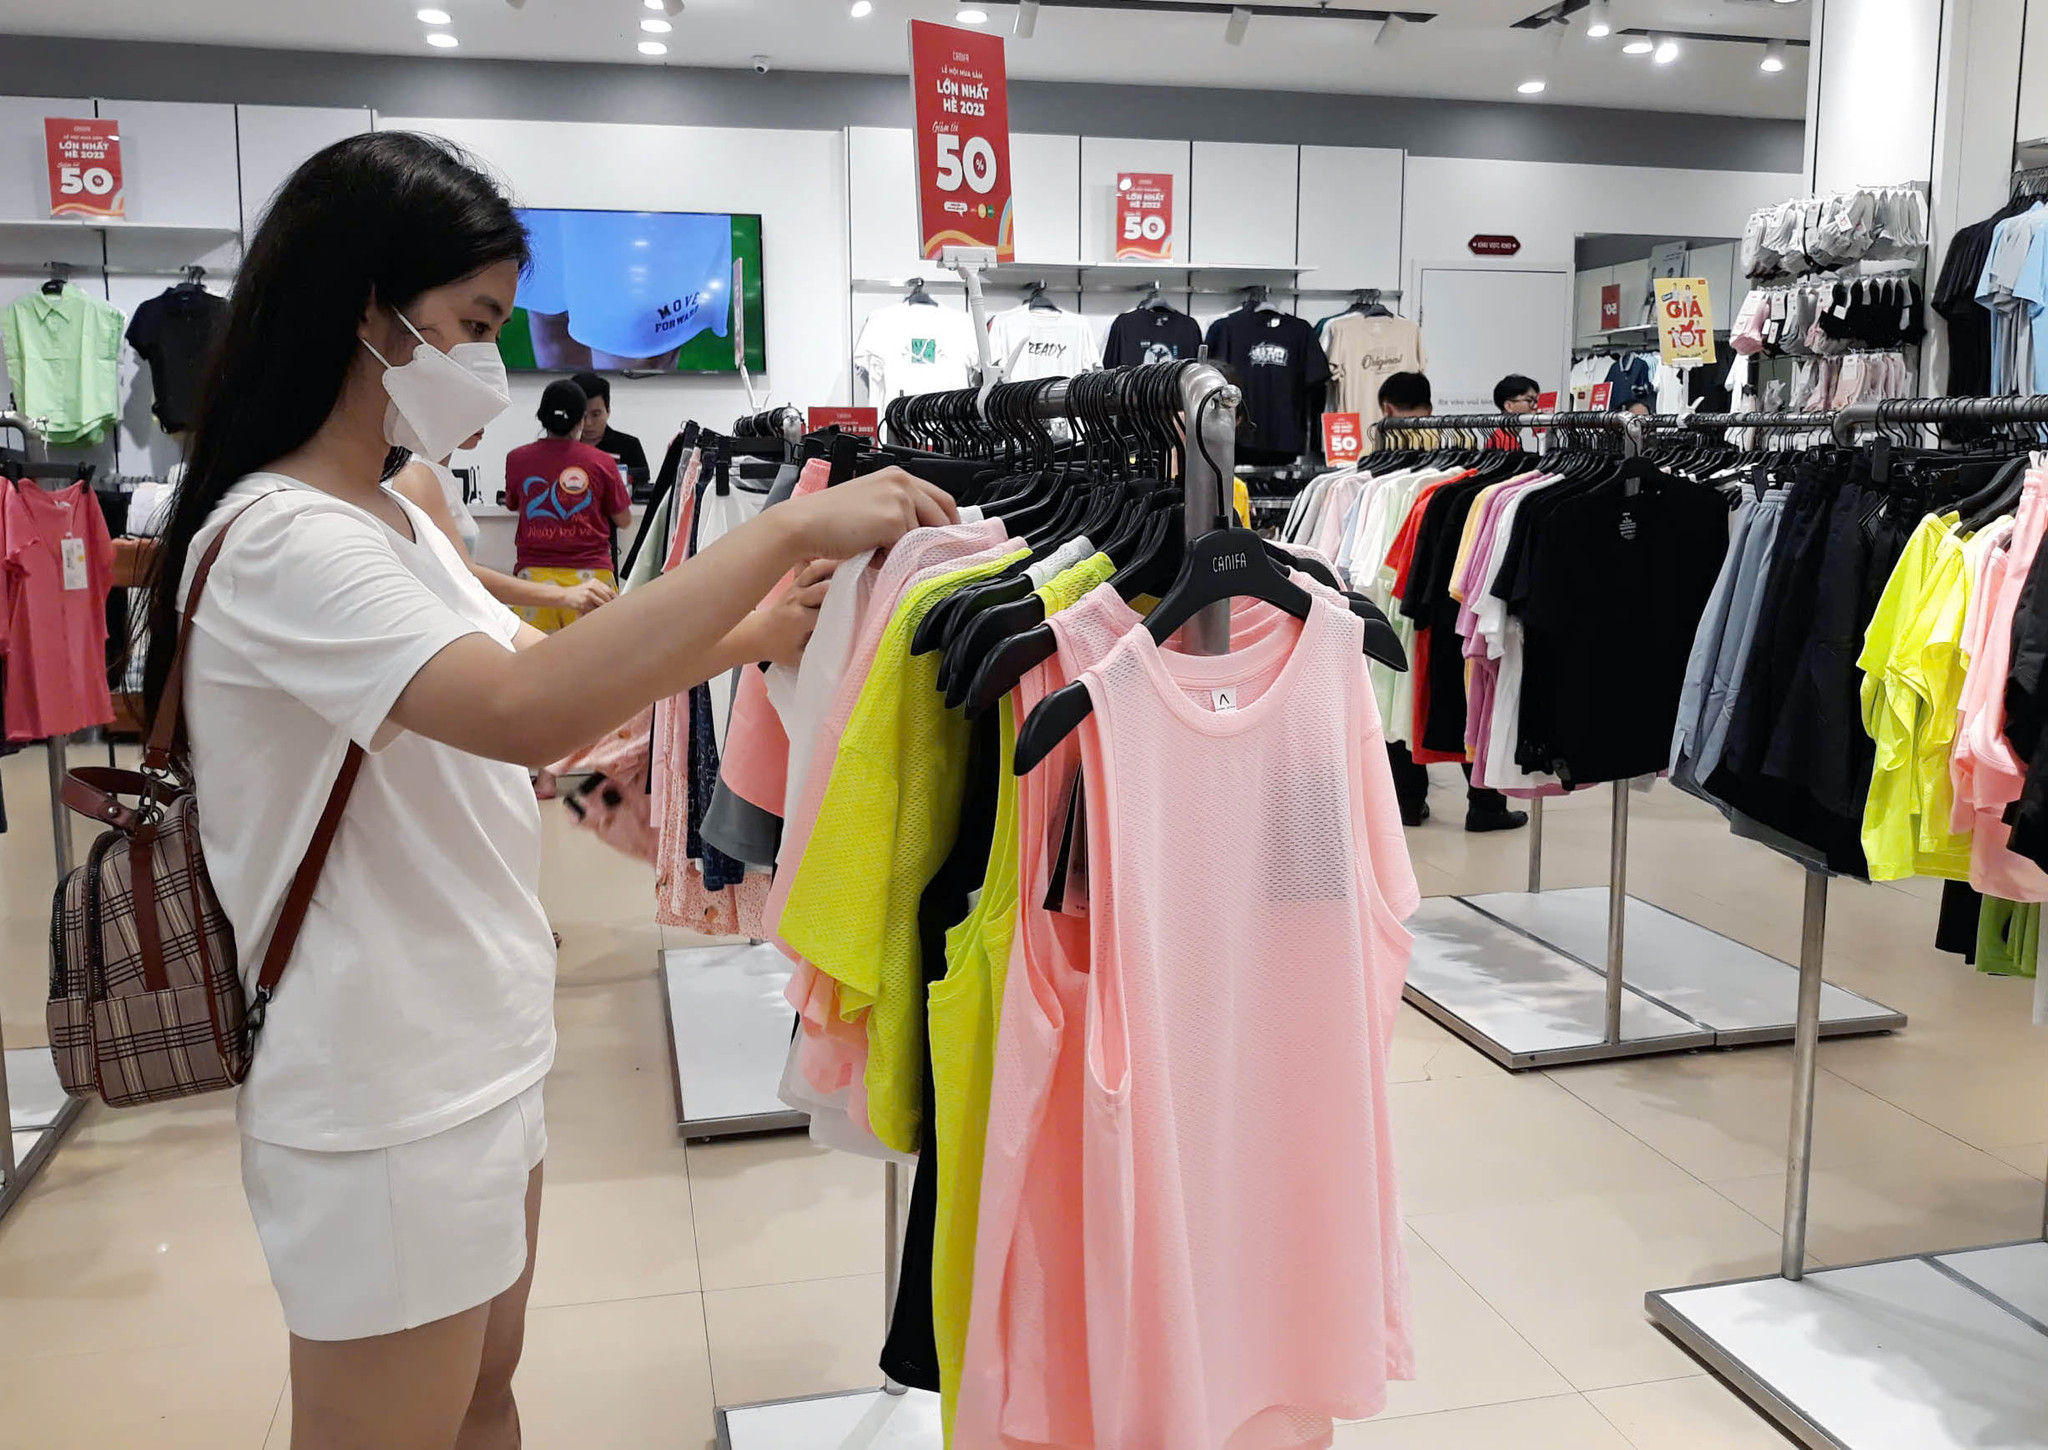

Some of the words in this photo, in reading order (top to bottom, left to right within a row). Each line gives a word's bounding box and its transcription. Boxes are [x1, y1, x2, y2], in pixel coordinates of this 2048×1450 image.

[936, 78, 959, 96] LỚN
[961, 82, 989, 100] NHẤT
[943, 96, 958, 113] HÈ
[959, 100, 986, 117] 2023
[59, 141, 79, 149] LỚN
[82, 140, 109, 150] NHẤT
[65, 150, 78, 158] HÈ
[81, 151, 104, 159] 2023
[657, 291, 700, 320] MOVE
[1666, 295, 1703, 319] GIÁ
[1212, 552, 1247, 573] CANIFA
